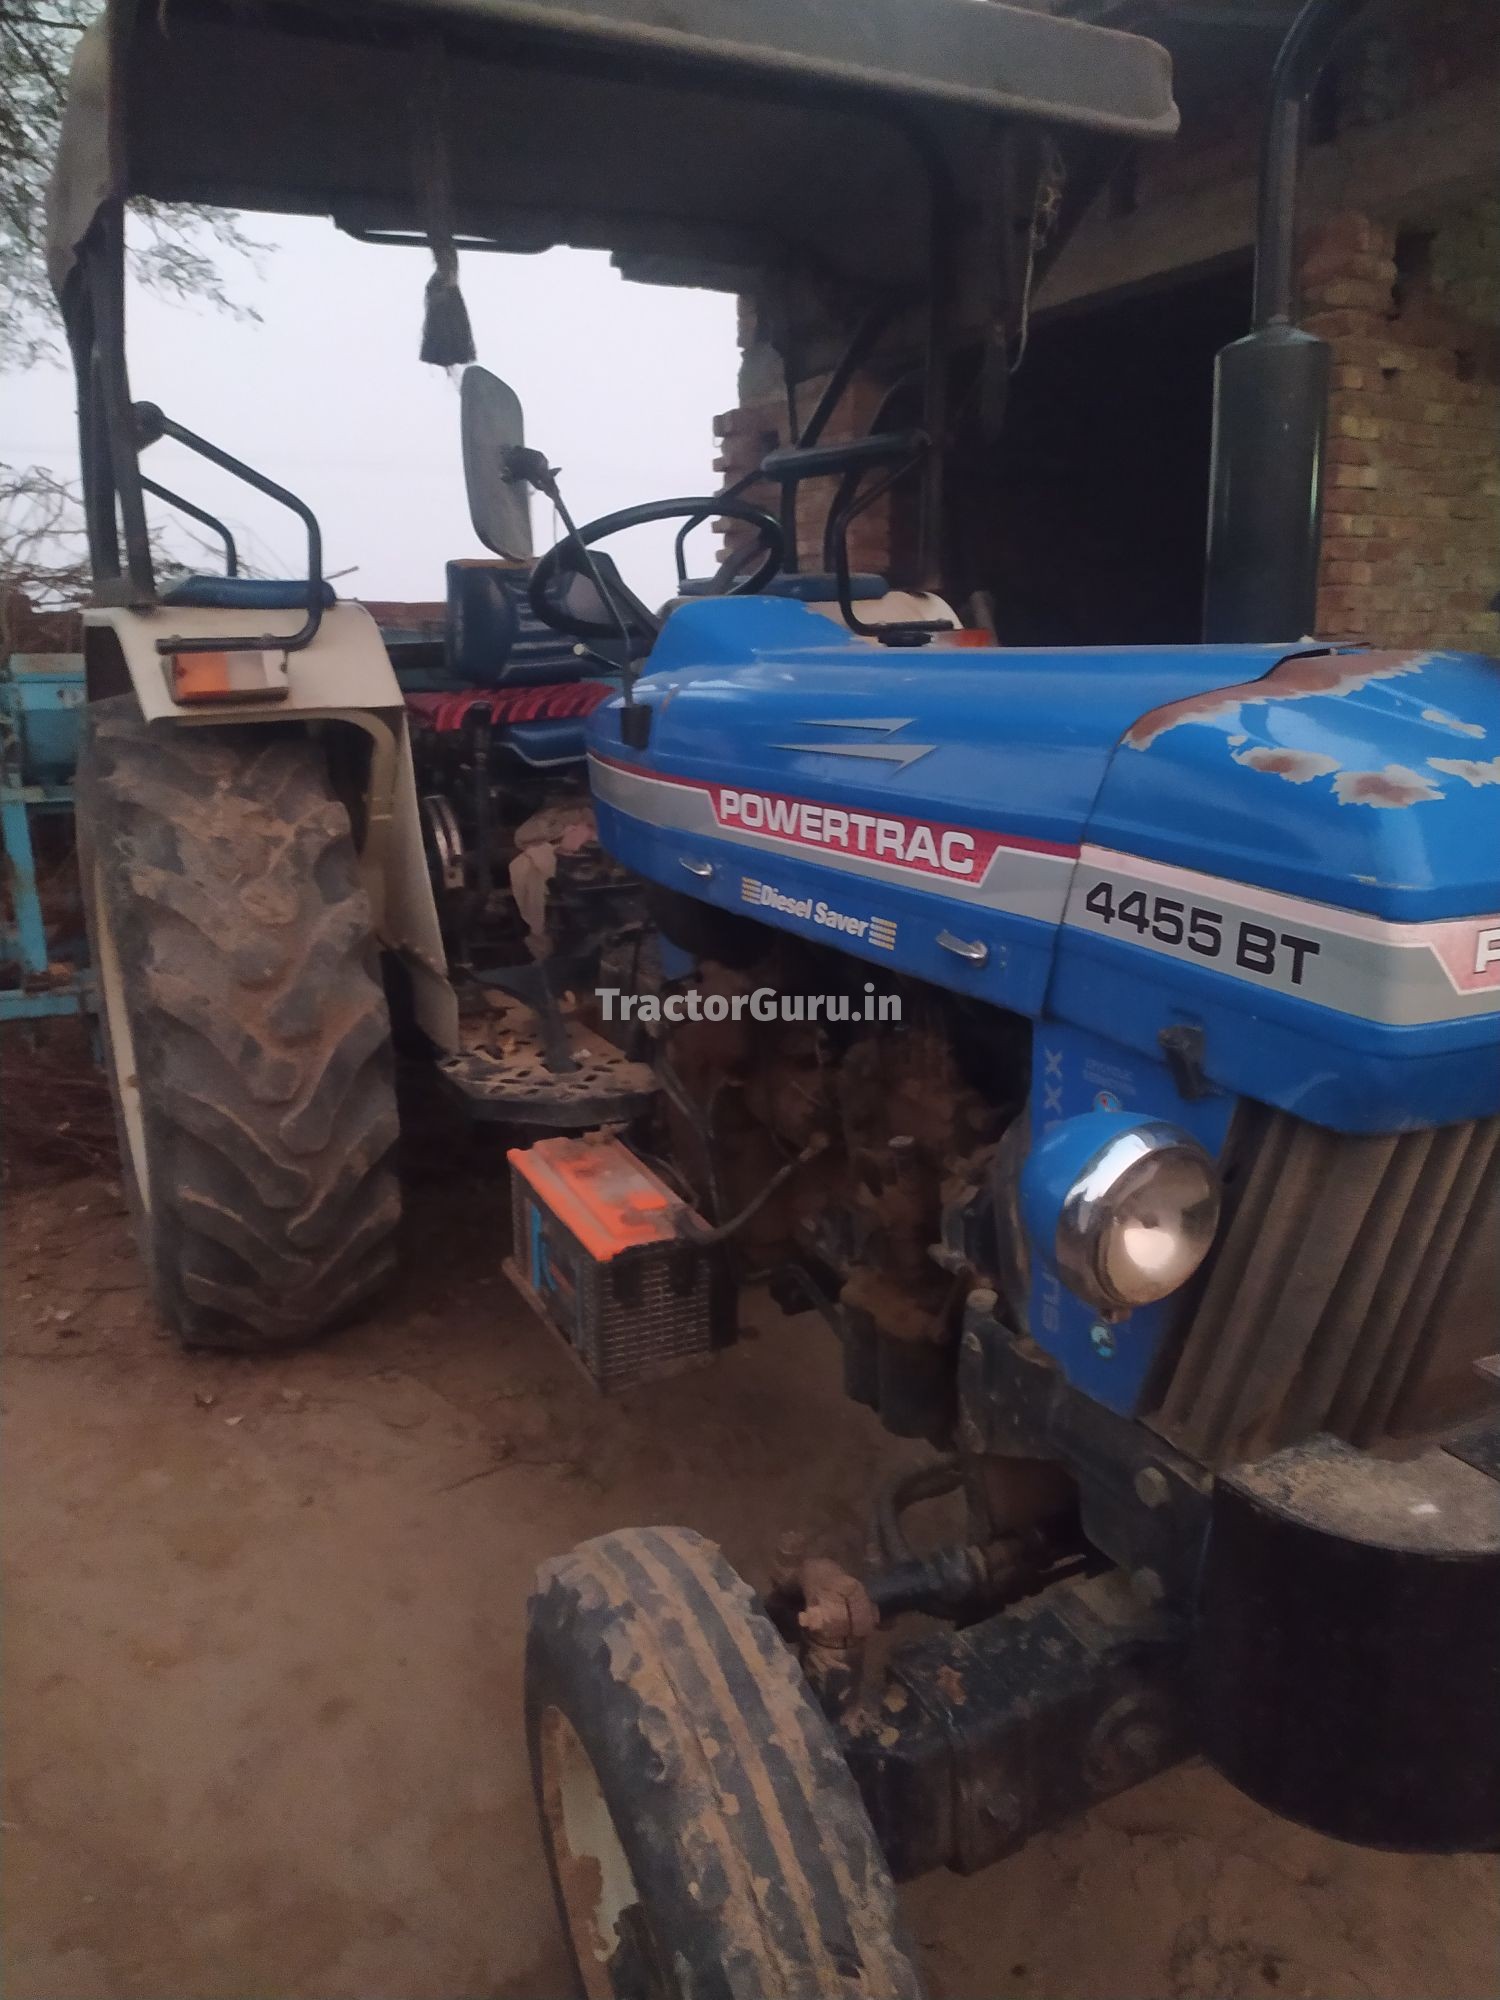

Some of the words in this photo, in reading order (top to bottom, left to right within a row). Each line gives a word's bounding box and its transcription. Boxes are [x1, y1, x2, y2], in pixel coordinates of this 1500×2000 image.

[720, 789, 974, 875] POWERTRAC
[760, 883, 813, 919] Diesel
[813, 901, 869, 938] Saver
[1086, 881, 1223, 957] 4455
[1236, 922, 1320, 984] BT
